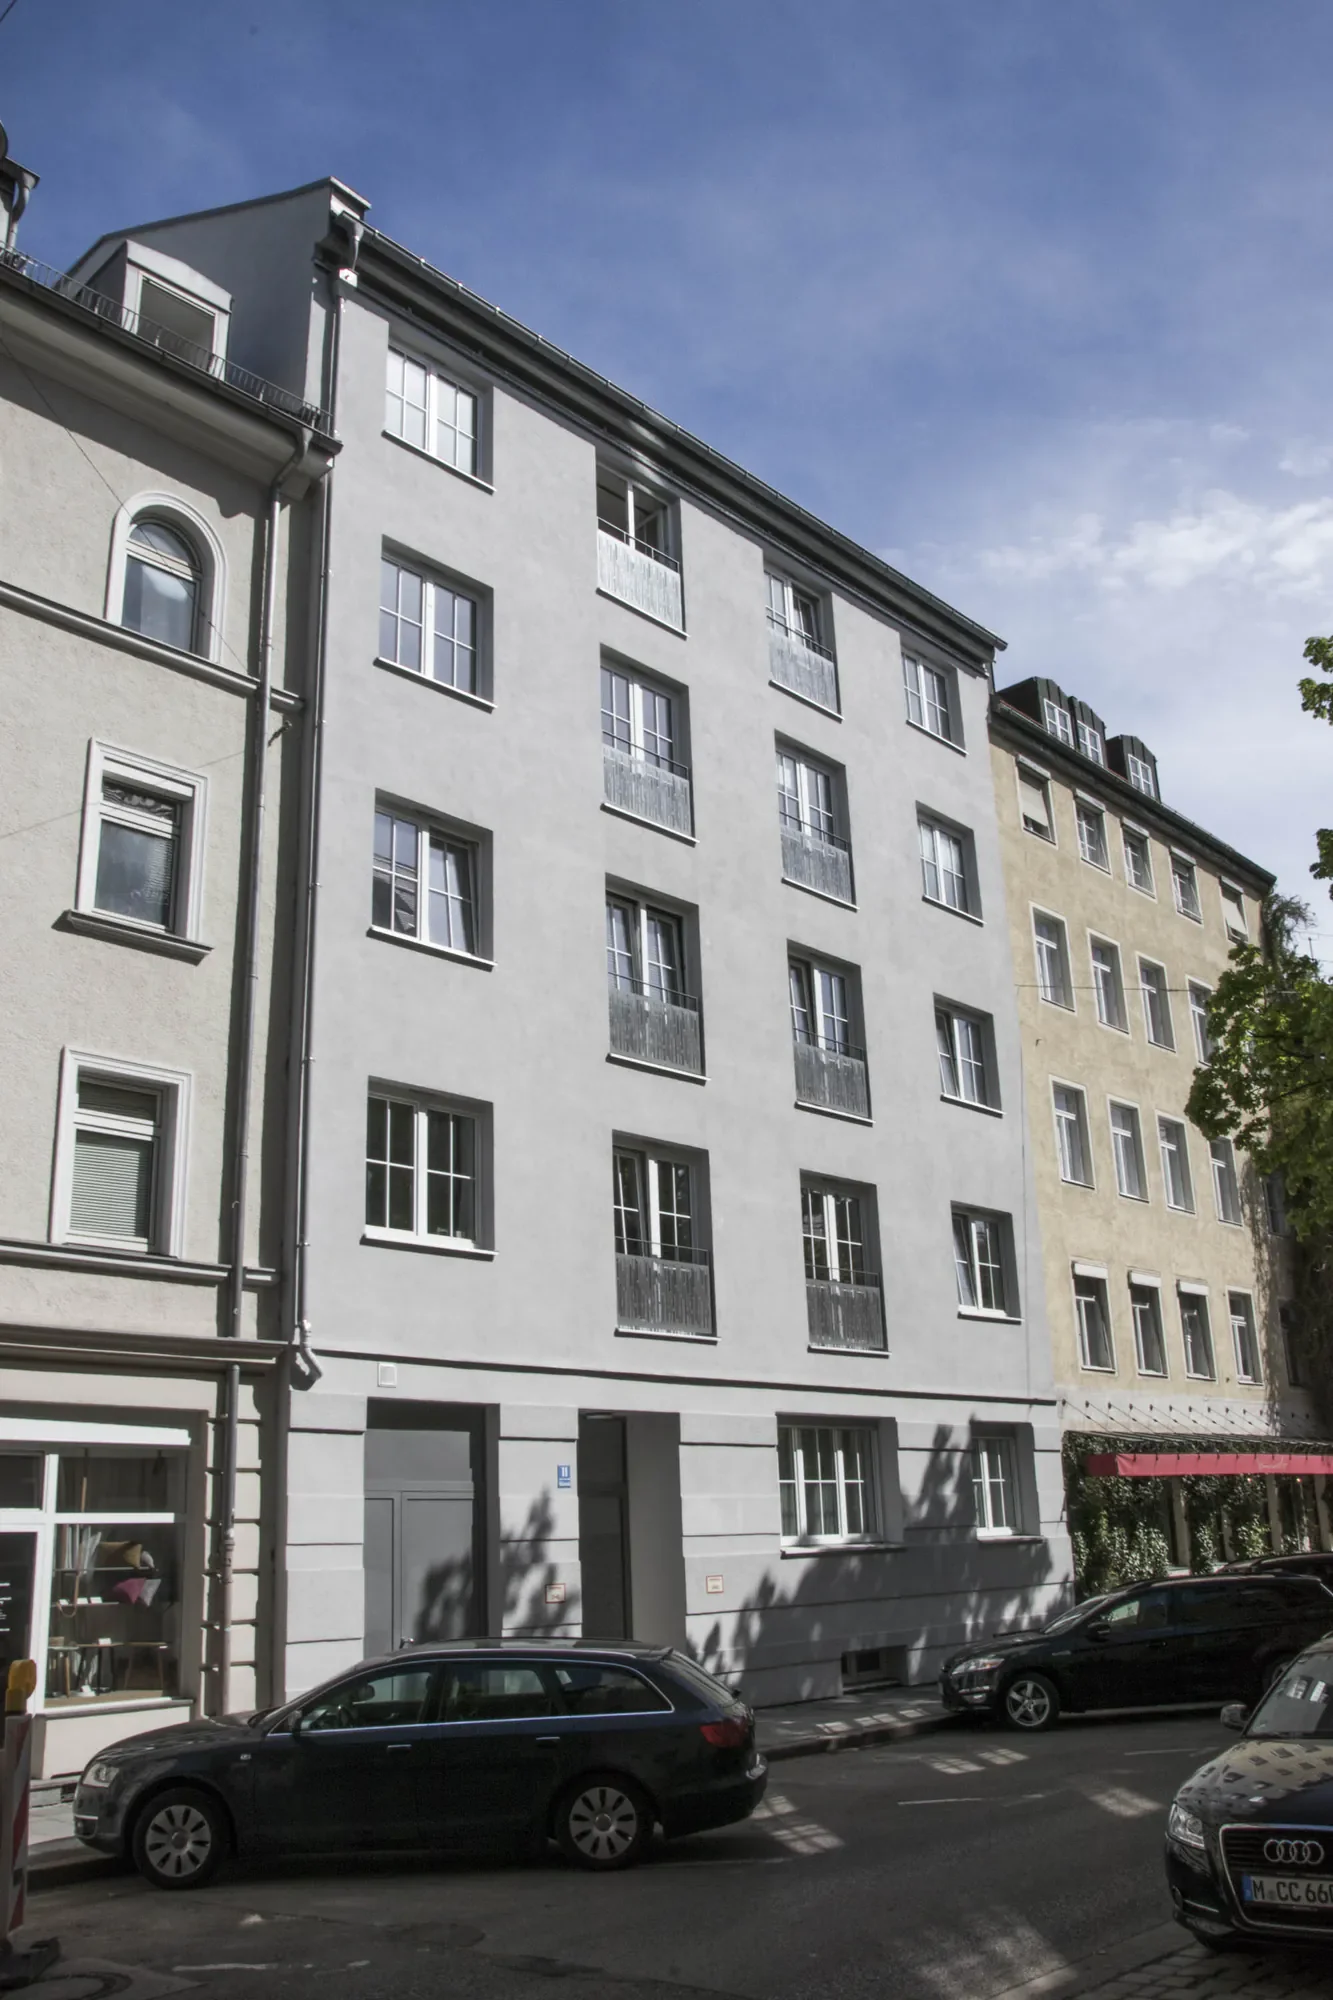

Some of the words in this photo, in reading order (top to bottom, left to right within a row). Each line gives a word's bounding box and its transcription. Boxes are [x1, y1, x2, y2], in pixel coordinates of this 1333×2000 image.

[561, 1466, 568, 1477] 11
[1252, 1879, 1265, 1900] M
[1276, 1881, 1301, 1902] CC
